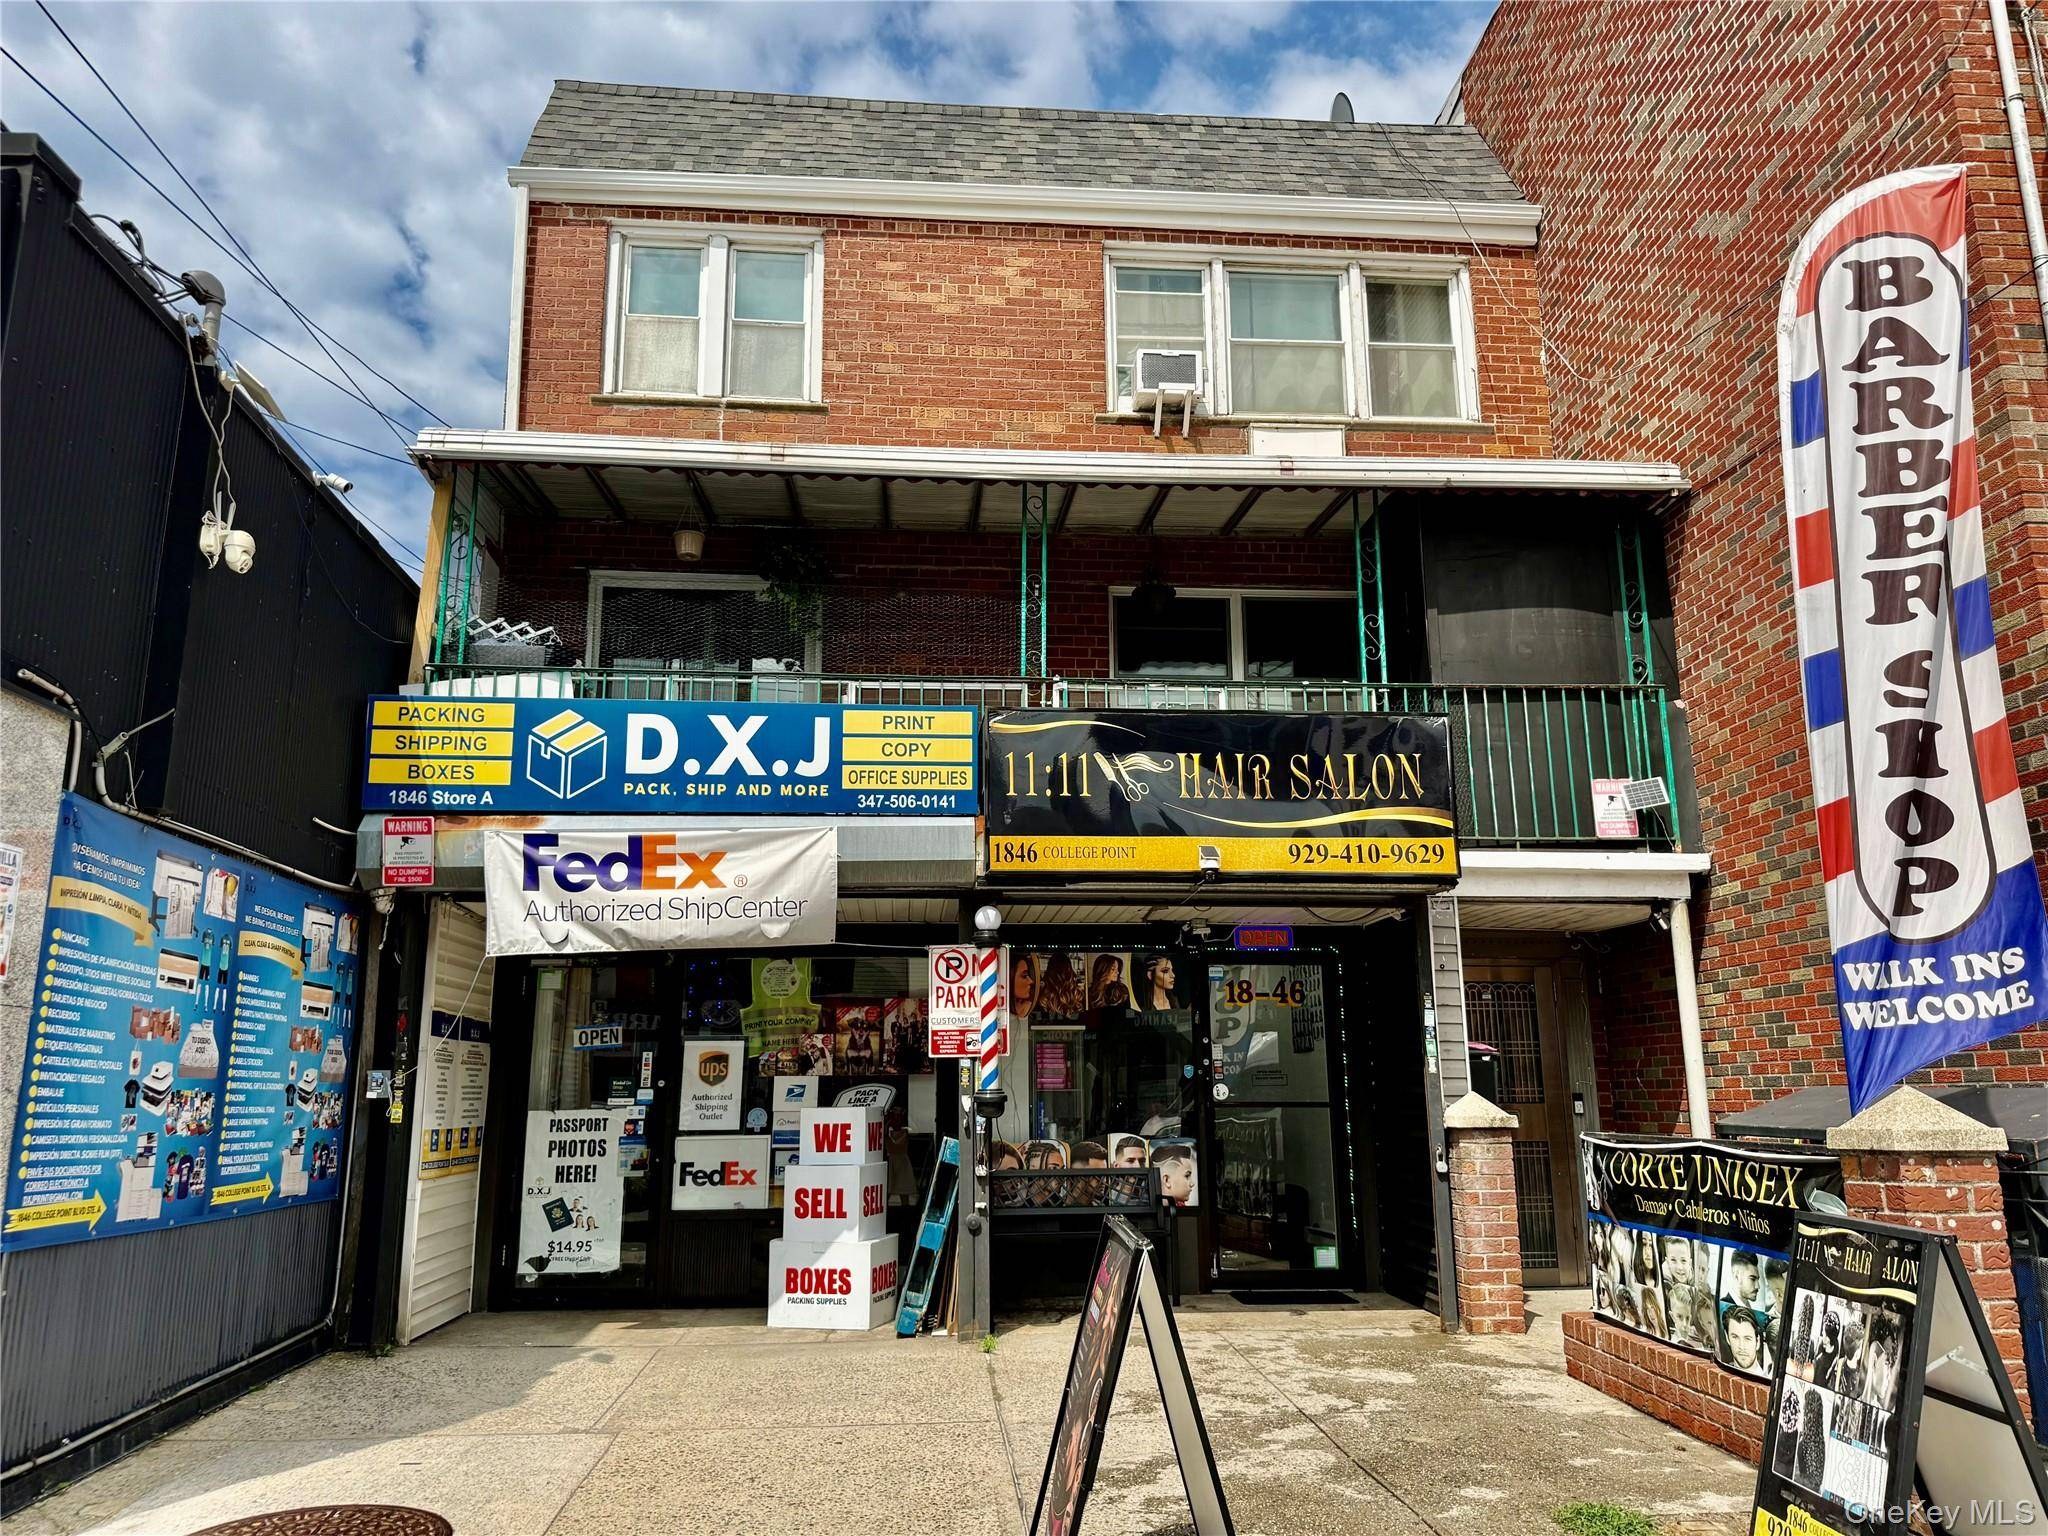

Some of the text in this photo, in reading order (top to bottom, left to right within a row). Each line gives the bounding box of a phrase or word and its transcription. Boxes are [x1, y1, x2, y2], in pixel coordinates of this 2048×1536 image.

[1841, 255, 1953, 626] BARBER
[398, 705, 486, 723] PACKING
[881, 714, 936, 731] PRINT
[395, 734, 488, 752] SHIPPING
[626, 712, 832, 777] D.X.J
[881, 742, 932, 758] COPY
[407, 763, 475, 781] BOXES
[847, 768, 968, 788] OFFICE SUPPLIES
[1004, 751, 1426, 802] 11:11 HAIR SALON
[624, 782, 830, 798] PACK, SHIP AND MORE
[1875, 649, 1959, 917] SHOP
[389, 789, 494, 806] 1846 Store A
[857, 794, 957, 809] 347-506-0141
[387, 820, 429, 833] WARNING
[522, 834, 728, 893] FedEx
[993, 842, 1137, 864] 1846 COLLEGE POINT
[1287, 842, 1445, 866] 929-410-9629
[387, 868, 429, 876] NO DUMPING
[523, 894, 809, 925] Authorized ShipCenter
[1238, 929, 1289, 947] OPEN
[971, 953, 981, 977] N
[1950, 945, 2025, 982] INS
[936, 985, 978, 1009] PARK
[1843, 980, 2035, 1031] WELCOME
[578, 1027, 620, 1047] OPEN
[701, 1060, 728, 1082] ups
[691, 1092, 733, 1102] Authorized
[848, 1095, 869, 1105] LIKE
[870, 1095, 877, 1104] A
[854, 1088, 880, 1097] PACK
[695, 1101, 729, 1112] Shipping
[699, 1111, 723, 1121] Outlet
[550, 1117, 609, 1133] PASSPORT
[867, 1120, 883, 1151] WE
[547, 1138, 607, 1158] PHOTOS
[813, 1123, 852, 1153] WE
[555, 1164, 597, 1184] HERE!
[679, 1161, 758, 1187] FedEx
[1609, 1150, 1804, 1210] CORTE UNISEX
[528, 1187, 551, 1195] D.X.J
[863, 1184, 884, 1218] SELL
[794, 1187, 847, 1219] SELL
[1634, 1193, 1669, 1216] Damas
[1737, 1208, 1771, 1236] Niños
[547, 1240, 593, 1253] $14.95
[1796, 1237, 1920, 1286] 11:11 HAIR ALON
[785, 1267, 852, 1295] BOXES
[871, 1260, 897, 1295] BOXES
[787, 1296, 848, 1306] PACKING SUPPLIES
[1787, 1508, 1809, 1534] 1846
